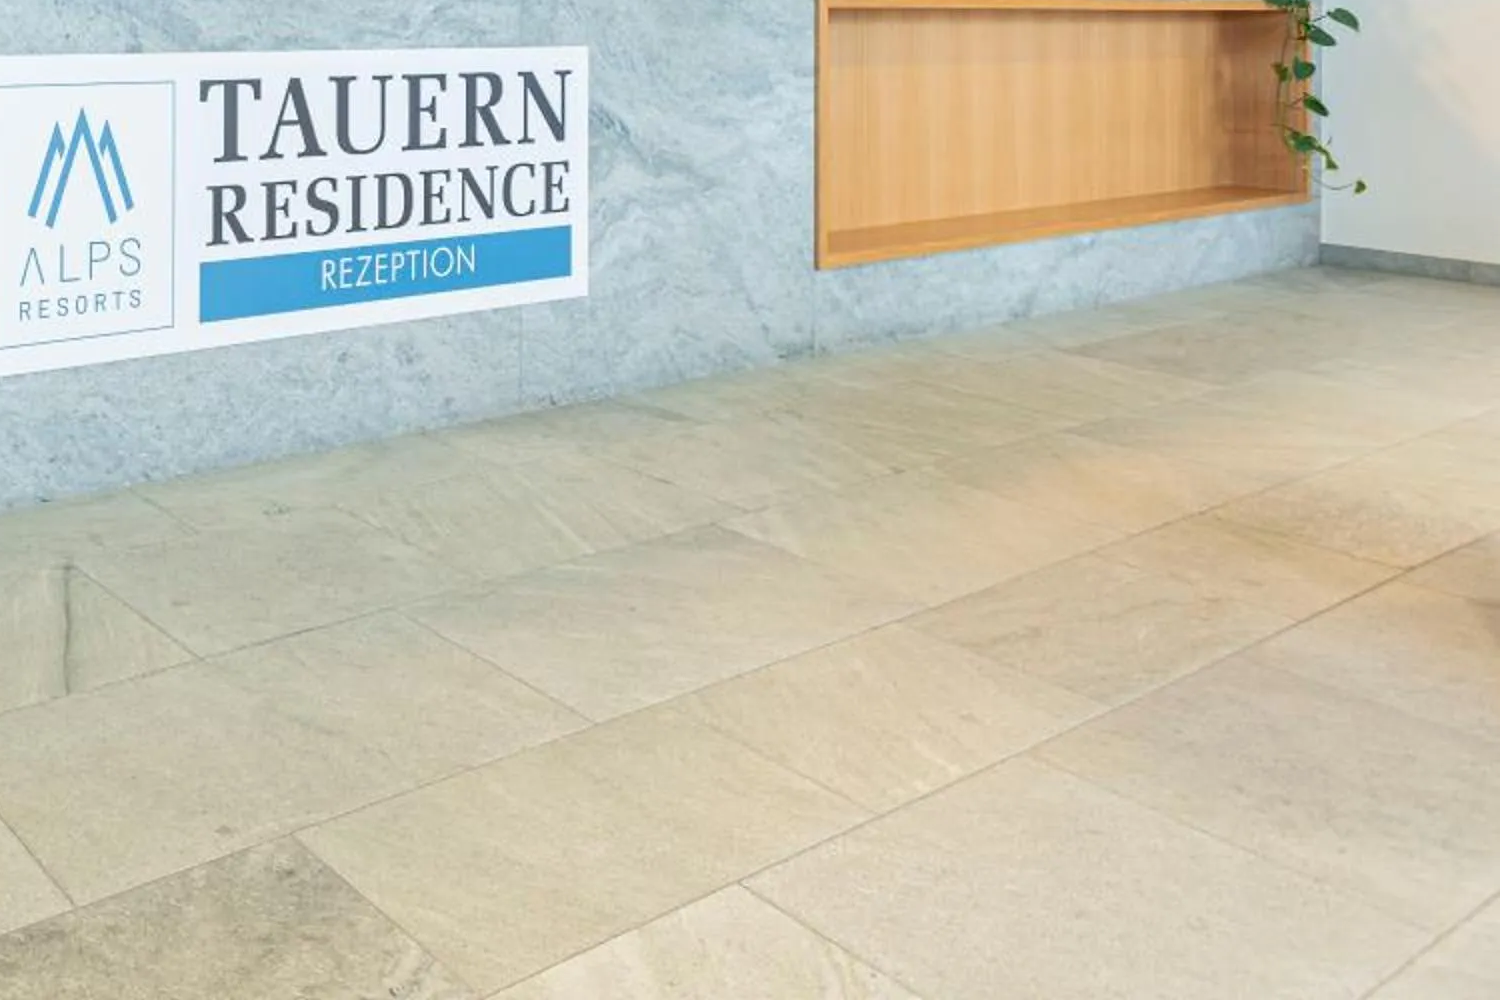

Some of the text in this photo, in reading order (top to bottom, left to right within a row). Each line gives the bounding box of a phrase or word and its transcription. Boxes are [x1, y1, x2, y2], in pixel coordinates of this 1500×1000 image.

[200, 69, 574, 163] TAUERN
[205, 160, 572, 246] RESIDENCE
[19, 236, 142, 287] ALPS
[320, 245, 477, 291] REZEPTION
[18, 289, 142, 322] RESORTS
